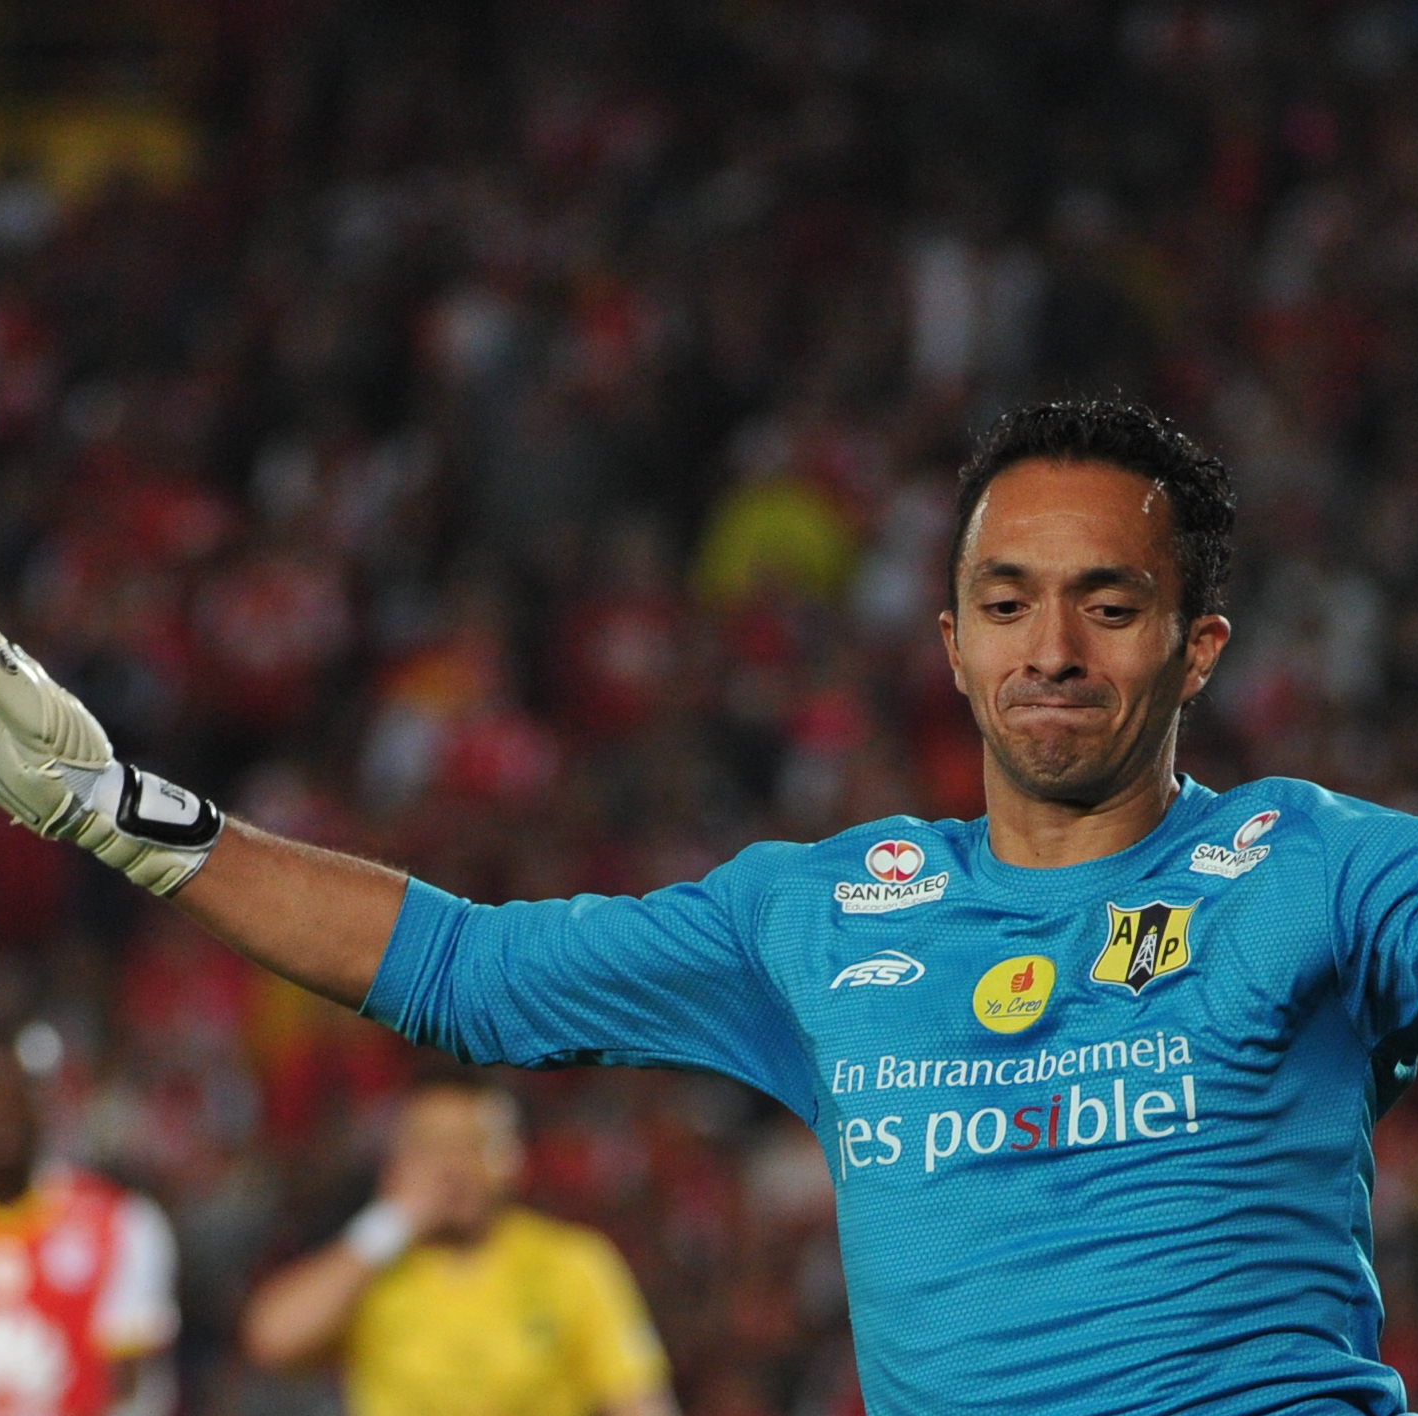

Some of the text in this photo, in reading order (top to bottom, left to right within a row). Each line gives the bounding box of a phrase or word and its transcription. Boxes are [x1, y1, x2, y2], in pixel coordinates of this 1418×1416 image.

[1193, 845, 1269, 867] SAN MATEO
[837, 873, 948, 901] SAN MATEO
[1111, 915, 1180, 967] A P
[984, 996, 1043, 1015] Yo Creo
[832, 1030, 1193, 1094] En Barrancabermeja
[837, 1074, 1199, 1181] ¡es posible!
